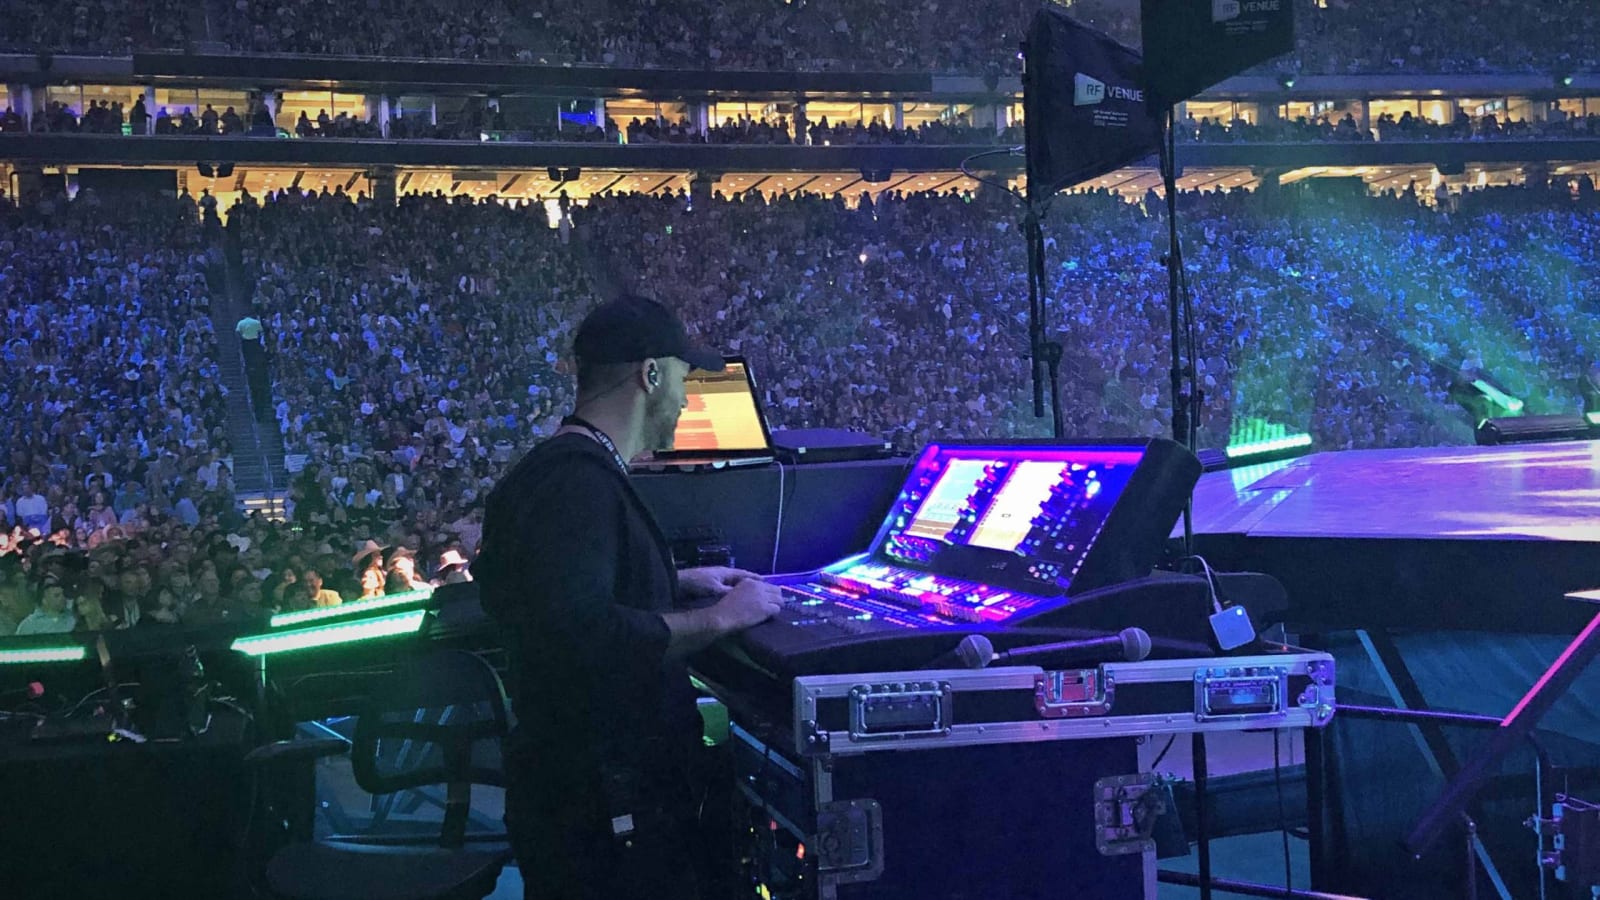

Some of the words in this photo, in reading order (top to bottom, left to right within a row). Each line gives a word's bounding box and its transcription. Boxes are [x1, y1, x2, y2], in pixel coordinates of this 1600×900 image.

[1242, 1, 1280, 12] VENUE
[1086, 84, 1102, 96] RF
[1106, 86, 1144, 102] VENUE
